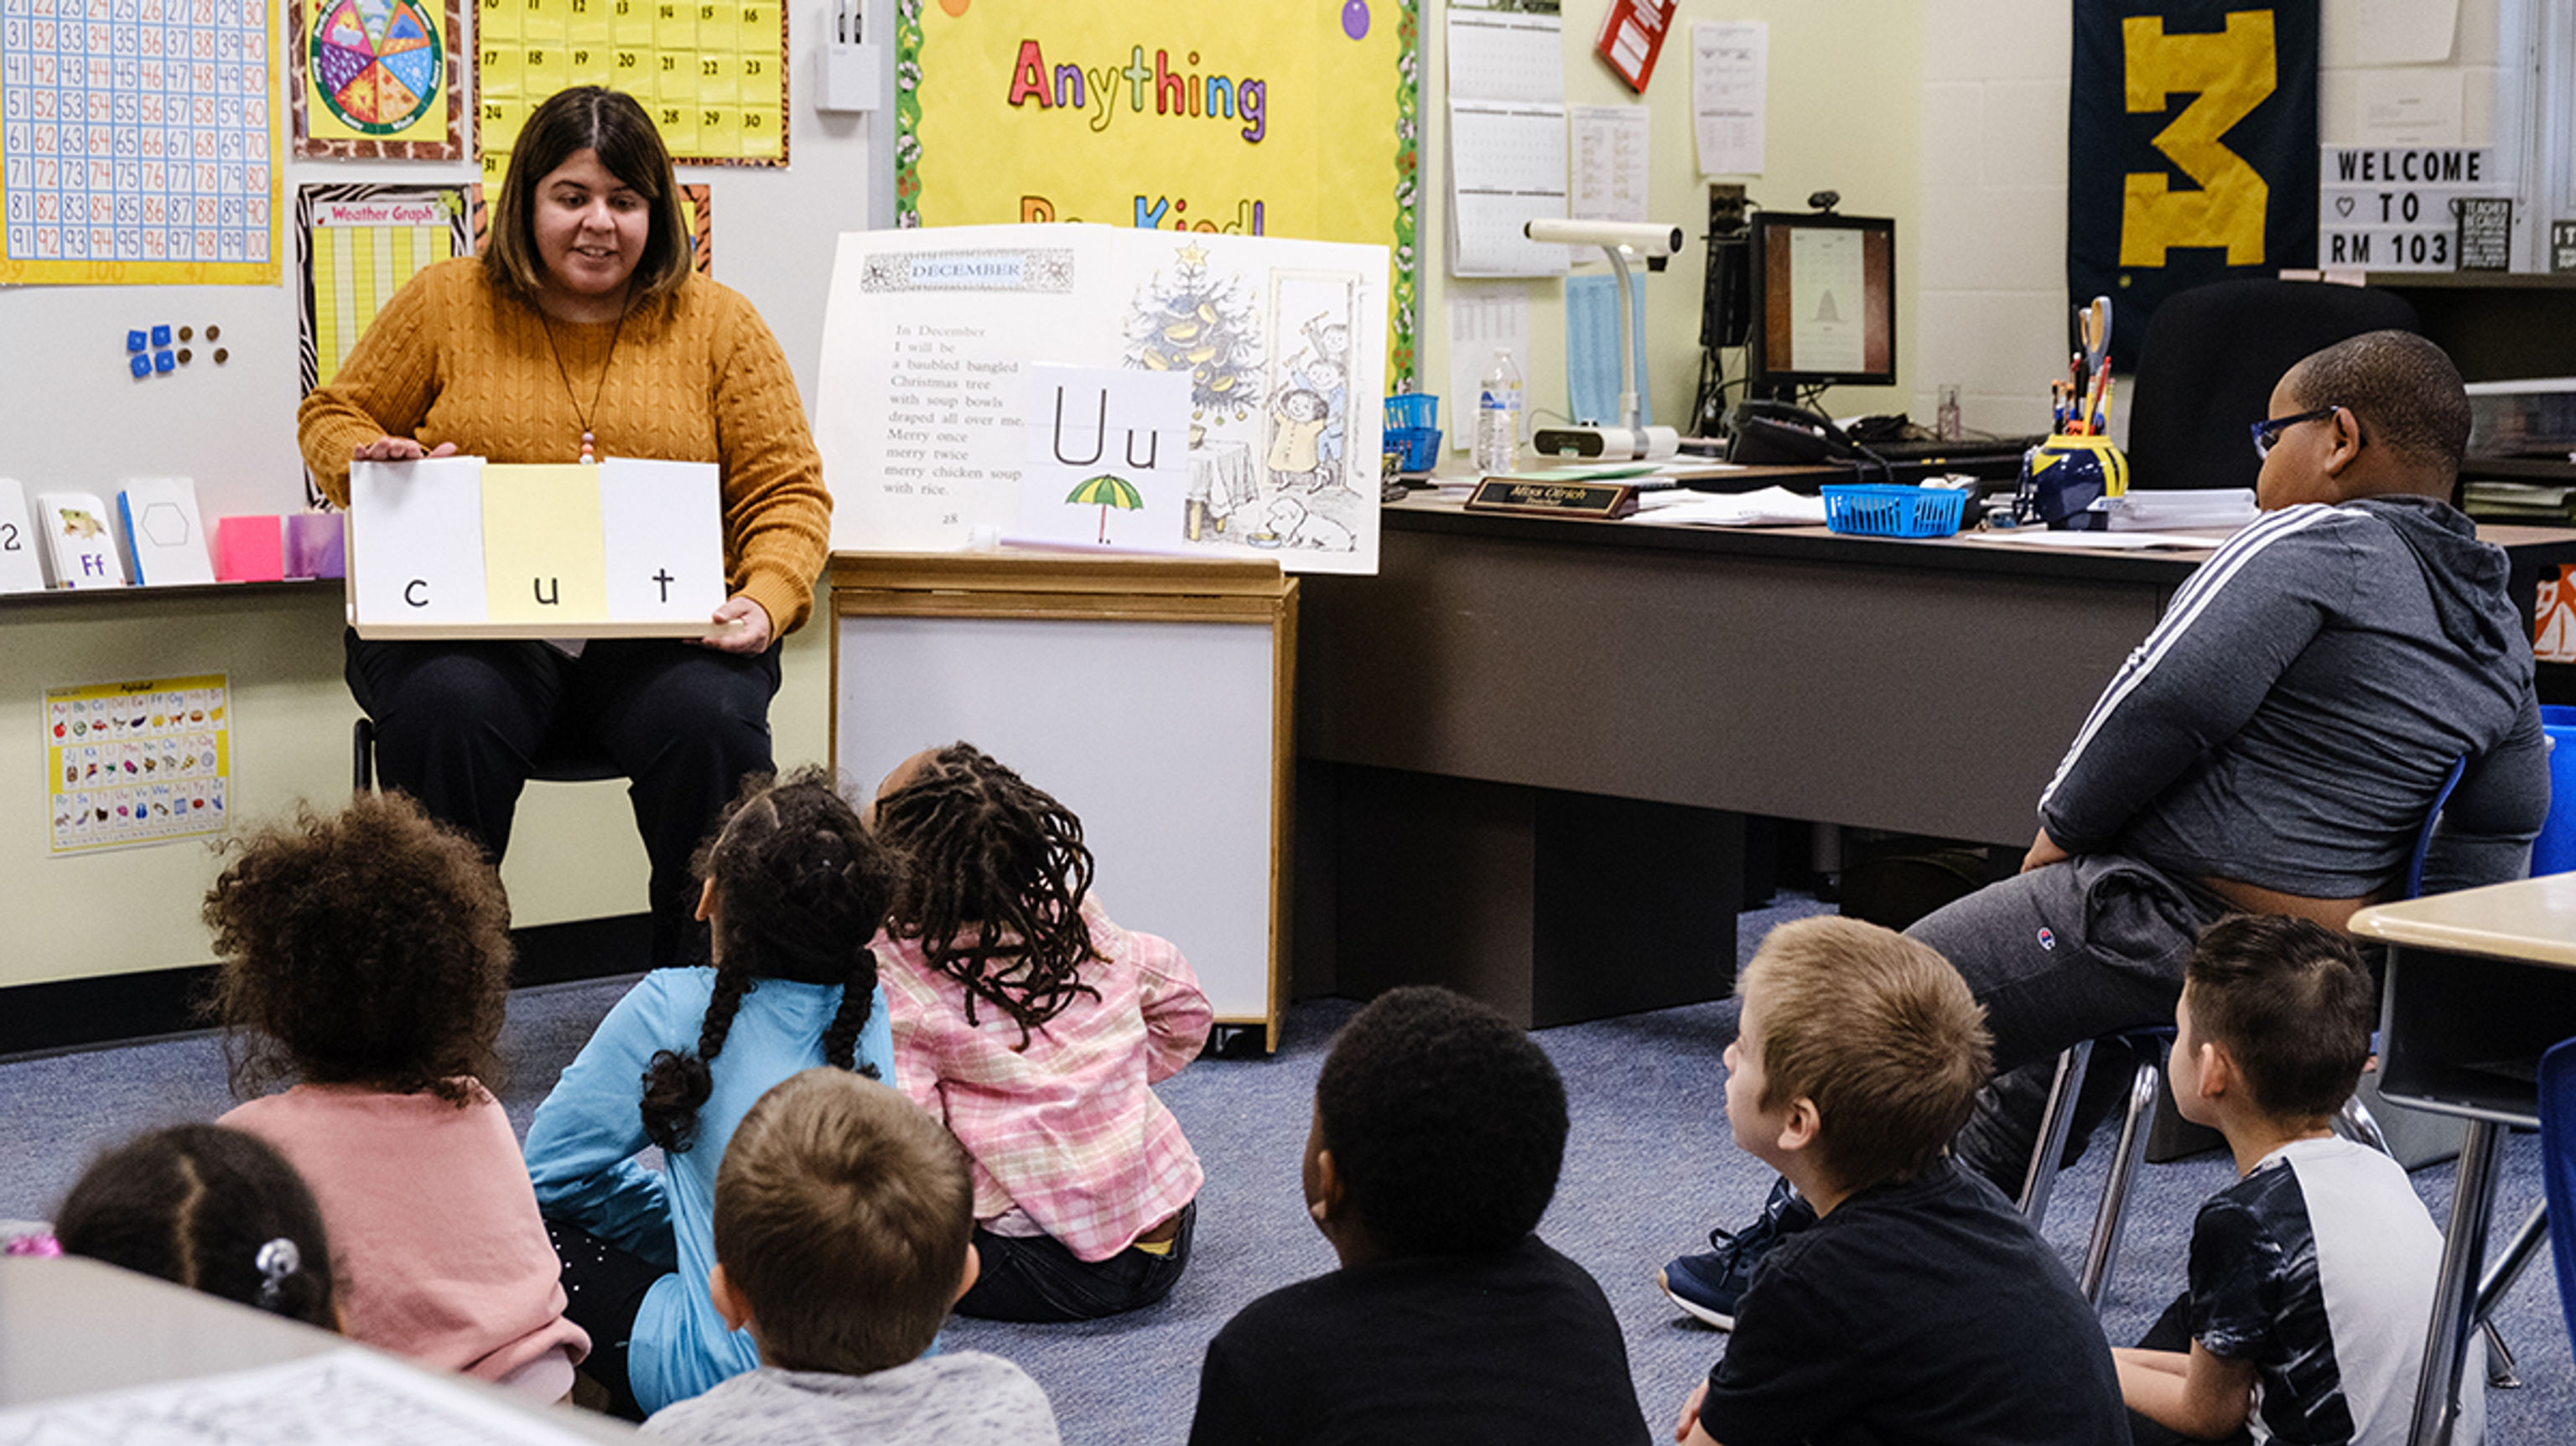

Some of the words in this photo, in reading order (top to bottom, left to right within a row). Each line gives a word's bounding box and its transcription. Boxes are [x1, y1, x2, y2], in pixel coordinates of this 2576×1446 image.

[89, 0, 108, 18] 24
[116, 0, 135, 18] 25
[142, 0, 161, 20] 26
[168, 0, 186, 21] 27
[193, 0, 212, 23] 28
[220, 0, 239, 24] 29
[244, 0, 263, 25] 30
[574, 0, 585, 12] 12
[616, 2, 628, 14] 13
[661, 5, 673, 18] 14
[702, 6, 713, 19] 15
[745, 9, 757, 22] 16
[8, 20, 29, 48] 31
[34, 22, 55, 49] 32
[60, 24, 83, 50] 33
[89, 25, 109, 51] 34
[114, 28, 136, 52] 35
[142, 29, 162, 54] 36
[169, 30, 190, 55] 37
[194, 32, 213, 56] 38
[220, 34, 241, 58] 39
[244, 34, 263, 60] 40
[8, 55, 30, 83] 41
[34, 58, 55, 84] 42
[61, 59, 83, 85] 43
[89, 60, 109, 86] 44
[114, 61, 135, 86] 45
[141, 64, 161, 87] 46
[168, 64, 187, 89] 47
[193, 65, 213, 91] 48
[219, 66, 242, 91] 49
[244, 67, 264, 92] 50
[485, 51, 496, 65] 17
[528, 51, 543, 65] 18
[575, 51, 588, 65] 19
[619, 54, 635, 67] 20
[662, 56, 674, 70] 21
[703, 60, 718, 75] 22
[745, 60, 761, 74] 23
[1007, 39, 1266, 143] Anything
[9, 90, 27, 117] 51
[35, 91, 56, 118] 52
[63, 93, 84, 118] 53
[89, 93, 110, 119] 54
[115, 95, 136, 120] 55
[143, 96, 163, 121] 56
[169, 97, 190, 122] 57
[194, 98, 213, 123] 58
[218, 100, 242, 124] 59
[245, 101, 264, 125] 60
[486, 106, 501, 119] 24
[663, 110, 679, 123] 28
[704, 111, 719, 125] 29
[745, 114, 761, 127] 30
[10, 125, 31, 152] 61
[35, 127, 55, 153] 62
[63, 127, 85, 153] 63
[89, 129, 110, 153] 64
[116, 129, 136, 154] 65
[143, 131, 163, 154] 66
[168, 131, 188, 156] 67
[195, 132, 215, 157] 68
[221, 132, 241, 158] 69
[247, 133, 266, 158] 70
[2119, 9, 2277, 268] M
[12, 159, 32, 186] 71
[36, 159, 56, 186] 72
[65, 161, 85, 187] 73
[90, 161, 111, 185] 74
[119, 163, 138, 188] 75
[143, 163, 164, 189] 76
[168, 164, 190, 189] 77
[196, 164, 216, 190] 78
[220, 166, 242, 190] 79
[247, 167, 267, 191] 80
[485, 158, 496, 172] 31
[2339, 151, 2481, 181] WELCOME
[12, 194, 29, 220] 81
[37, 194, 58, 220] 82
[64, 194, 87, 220] 83
[91, 195, 112, 221] 84
[117, 196, 140, 221] 85
[144, 197, 165, 222] 86
[169, 198, 192, 222] 87
[196, 198, 216, 224] 88
[221, 199, 243, 224] 89
[247, 200, 267, 224] 90
[331, 206, 388, 221] Weather
[392, 205, 433, 225] Graph
[2379, 192, 2419, 222] TO
[13, 228, 34, 254] 91
[38, 228, 59, 255] 92
[65, 229, 88, 254] 93
[91, 230, 112, 252] 94
[117, 230, 140, 255] 95
[144, 231, 165, 257] 96
[169, 231, 192, 256] 97
[196, 231, 216, 257] 98
[220, 232, 243, 257] 99
[247, 232, 266, 257] 100
[2332, 234, 2370, 263] RM
[2392, 233, 2448, 264] 103
[912, 264, 1021, 277] DECEMBER
[897, 325, 911, 336] In
[919, 325, 986, 337] December
[895, 341, 901, 352] I
[908, 342, 932, 353] will
[940, 343, 955, 354] be
[892, 361, 900, 370] a
[907, 360, 959, 371] baubled
[967, 361, 1019, 375] bangled
[891, 375, 958, 389] Christmas
[966, 379, 991, 390] tree
[889, 394, 920, 405] with
[927, 396, 958, 408] soup
[965, 396, 1004, 407] bowls
[888, 412, 935, 425] draped
[942, 413, 958, 424] all
[964, 416, 994, 426] over
[1000, 417, 1026, 427] me.
[886, 428, 930, 443] Merry
[937, 432, 969, 443] once
[886, 448, 927, 461] merry
[933, 448, 969, 460] twice
[884, 465, 925, 479] merry
[932, 466, 983, 479] chicken
[990, 469, 1023, 482] soup
[883, 483, 913, 495] with
[921, 484, 949, 495] rice.
[943, 514, 958, 525] 28
[81, 554, 104, 576] Ff
